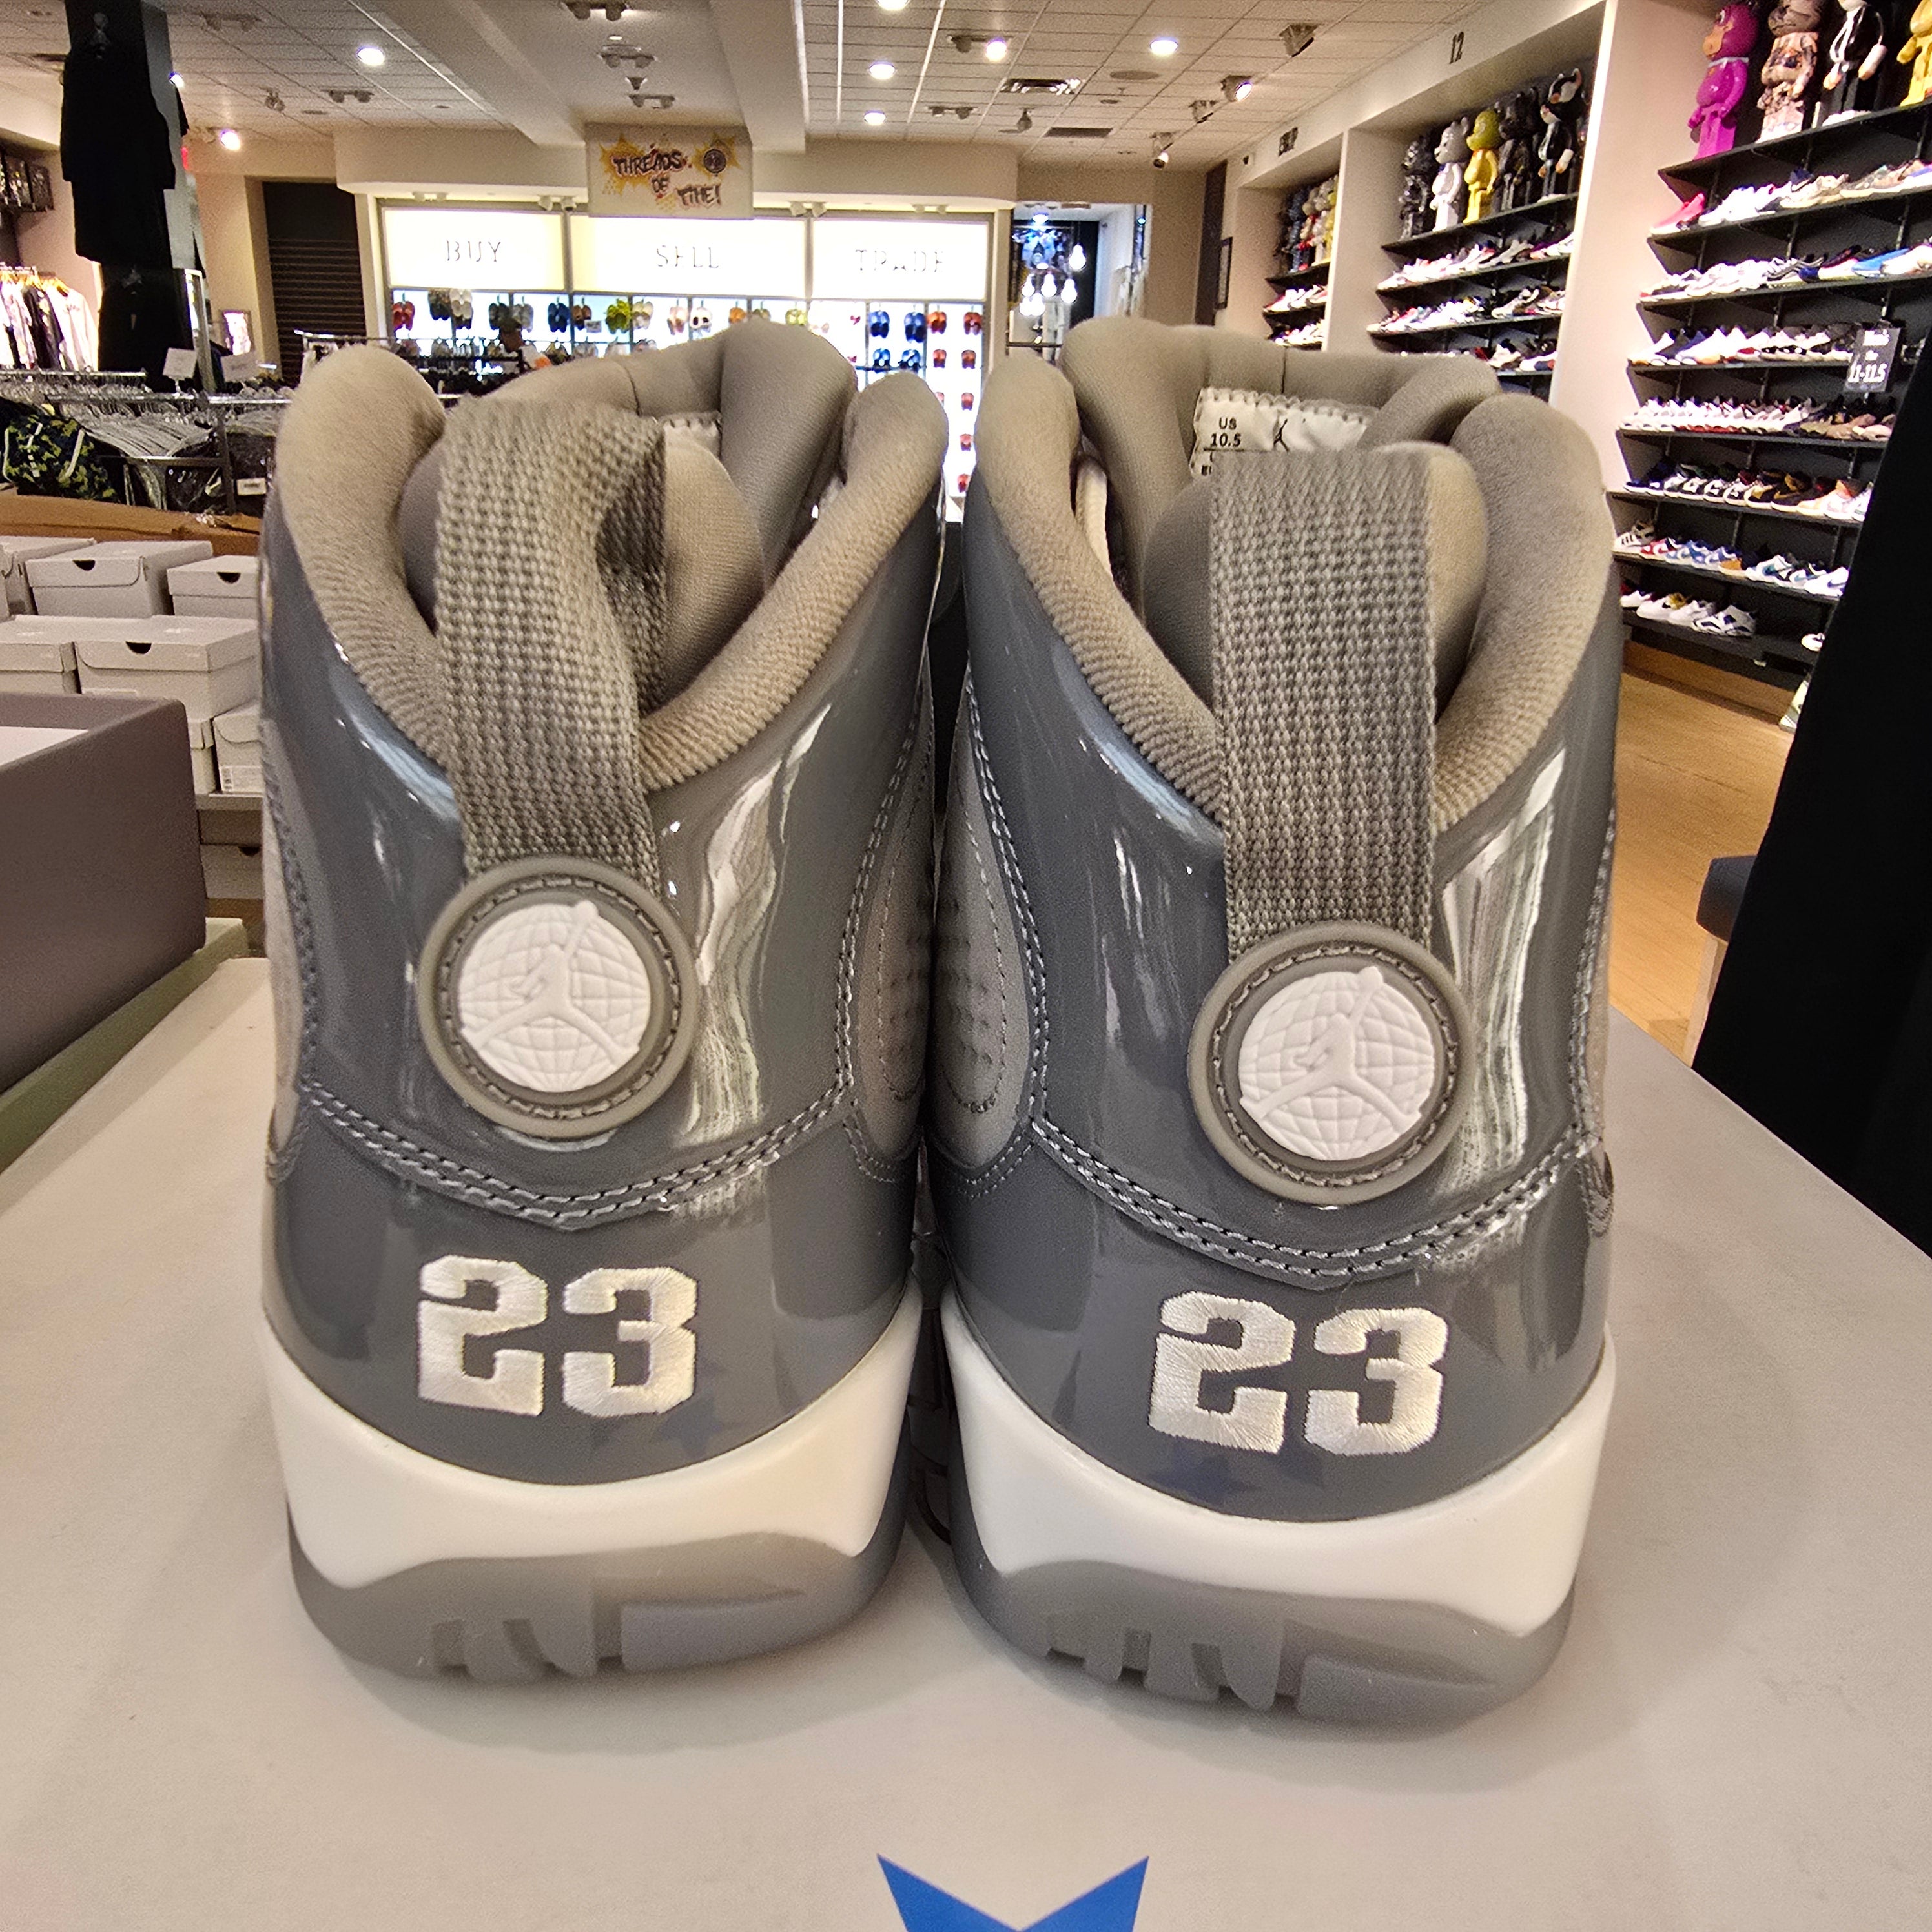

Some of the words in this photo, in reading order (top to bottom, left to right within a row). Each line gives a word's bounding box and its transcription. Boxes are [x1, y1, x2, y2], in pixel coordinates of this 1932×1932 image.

[613, 149, 683, 174] THREADS
[652, 177, 670, 193] OF
[446, 240, 502, 263] BUY
[656, 245, 719, 269] SELL
[1218, 417, 1237, 430] US
[1210, 433, 1242, 447] 10.5
[418, 1255, 697, 1418] 23
[1148, 1291, 1449, 1457] 23
